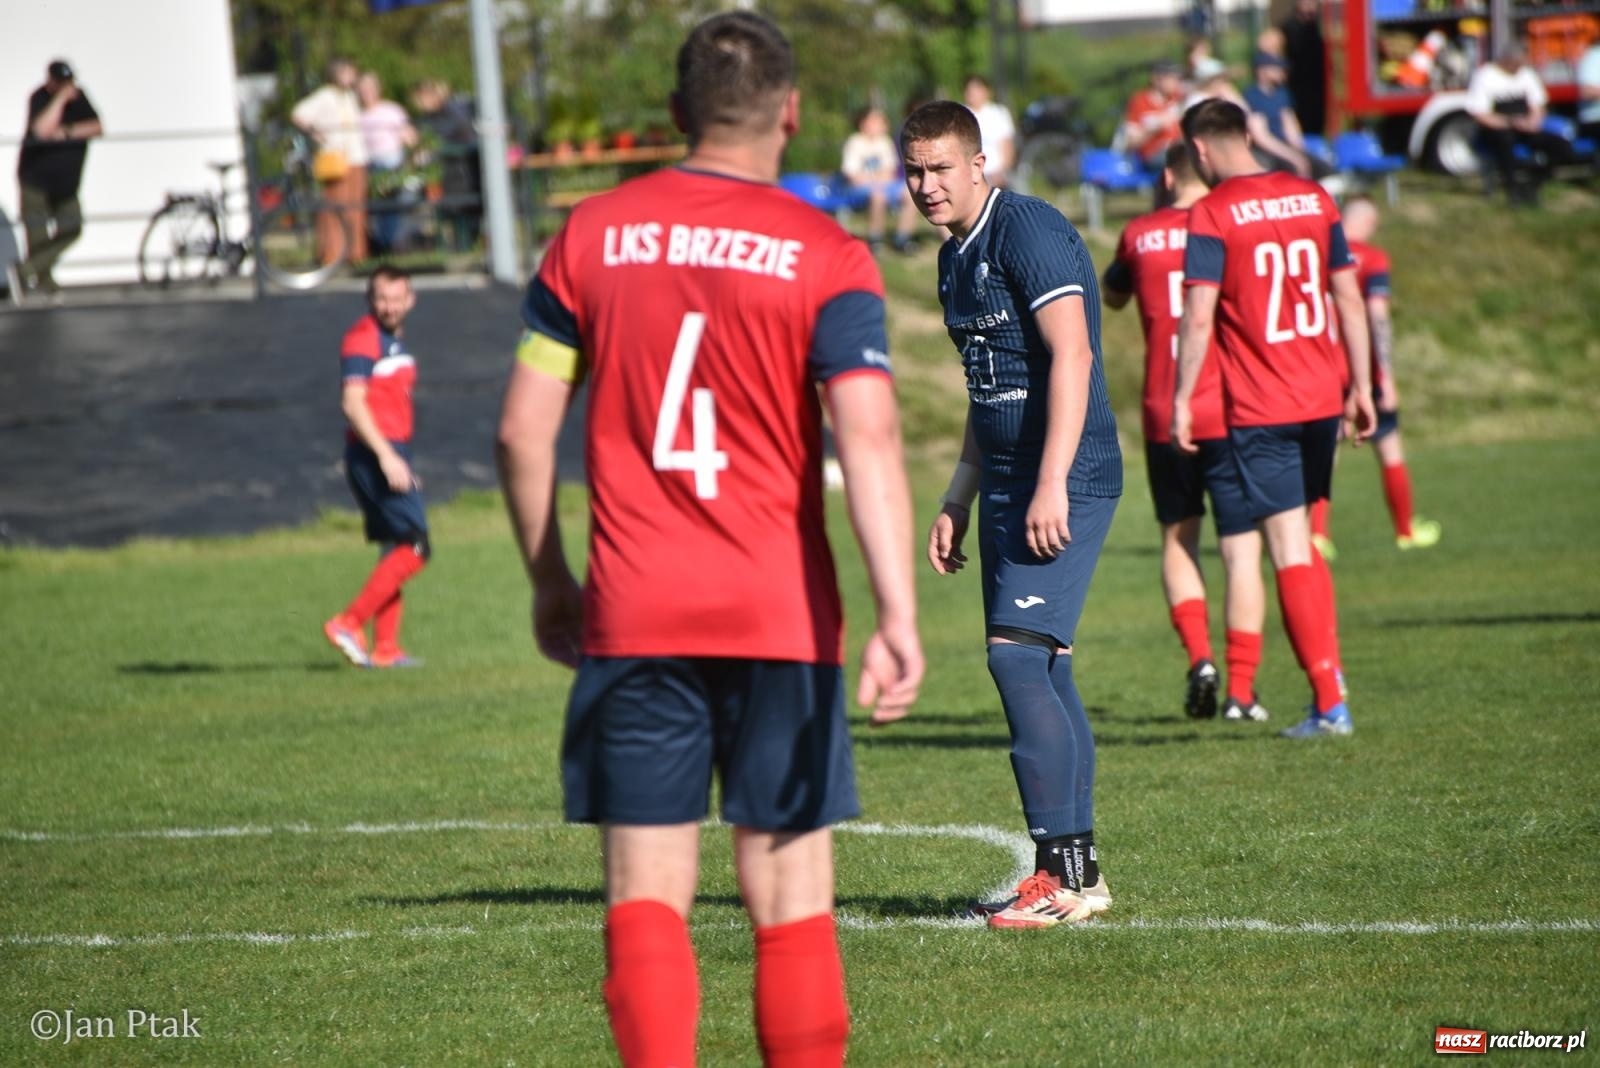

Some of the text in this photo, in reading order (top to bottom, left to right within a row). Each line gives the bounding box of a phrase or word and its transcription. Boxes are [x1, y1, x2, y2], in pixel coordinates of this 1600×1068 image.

[1230, 193, 1323, 226] LKS BRZEZIE
[603, 221, 804, 281] LKS BRZEZIE
[1136, 230, 1166, 254] LKS
[1254, 238, 1326, 344] 23
[976, 309, 1008, 329] GSM
[652, 312, 729, 500] 4
